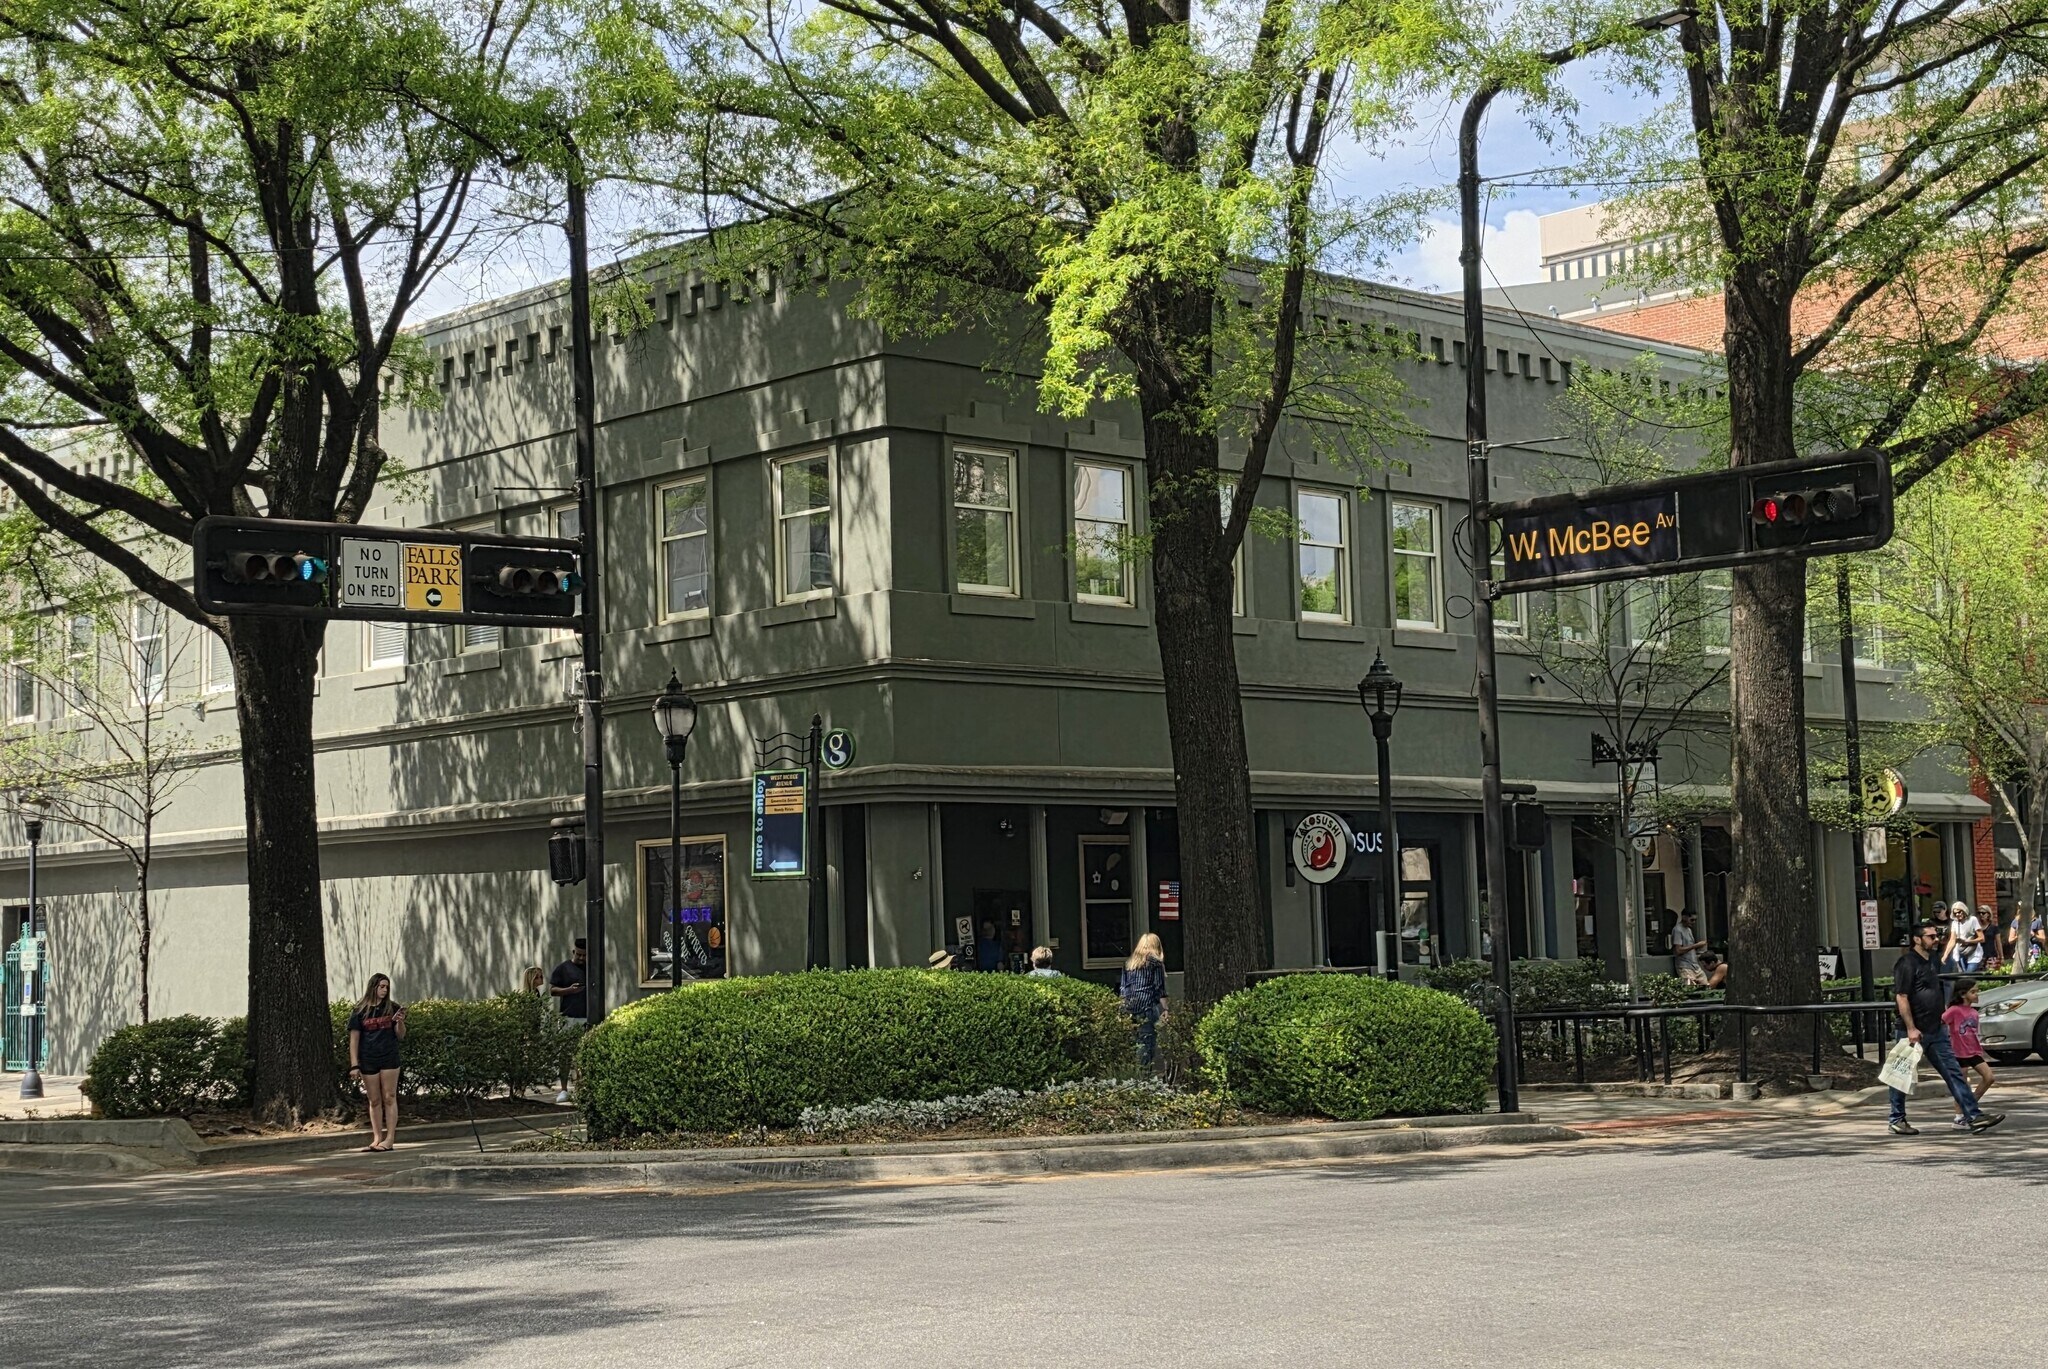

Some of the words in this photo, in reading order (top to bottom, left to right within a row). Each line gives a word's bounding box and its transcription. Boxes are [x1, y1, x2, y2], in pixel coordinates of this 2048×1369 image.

[1509, 530, 1542, 562] W.
[1549, 520, 1651, 558] McBee
[1656, 512, 1675, 530] Av
[360, 548, 382, 561] NO
[406, 546, 460, 567] FALLS
[354, 565, 389, 580] TURN
[406, 565, 460, 586] PARK
[347, 584, 366, 597] ON
[371, 585, 396, 598] RED
[755, 778, 766, 815] enjoy
[755, 817, 764, 832] to
[1295, 815, 1341, 839] TAKOSUSHI
[755, 834, 764, 869] more
[1636, 838, 1646, 848] 32
